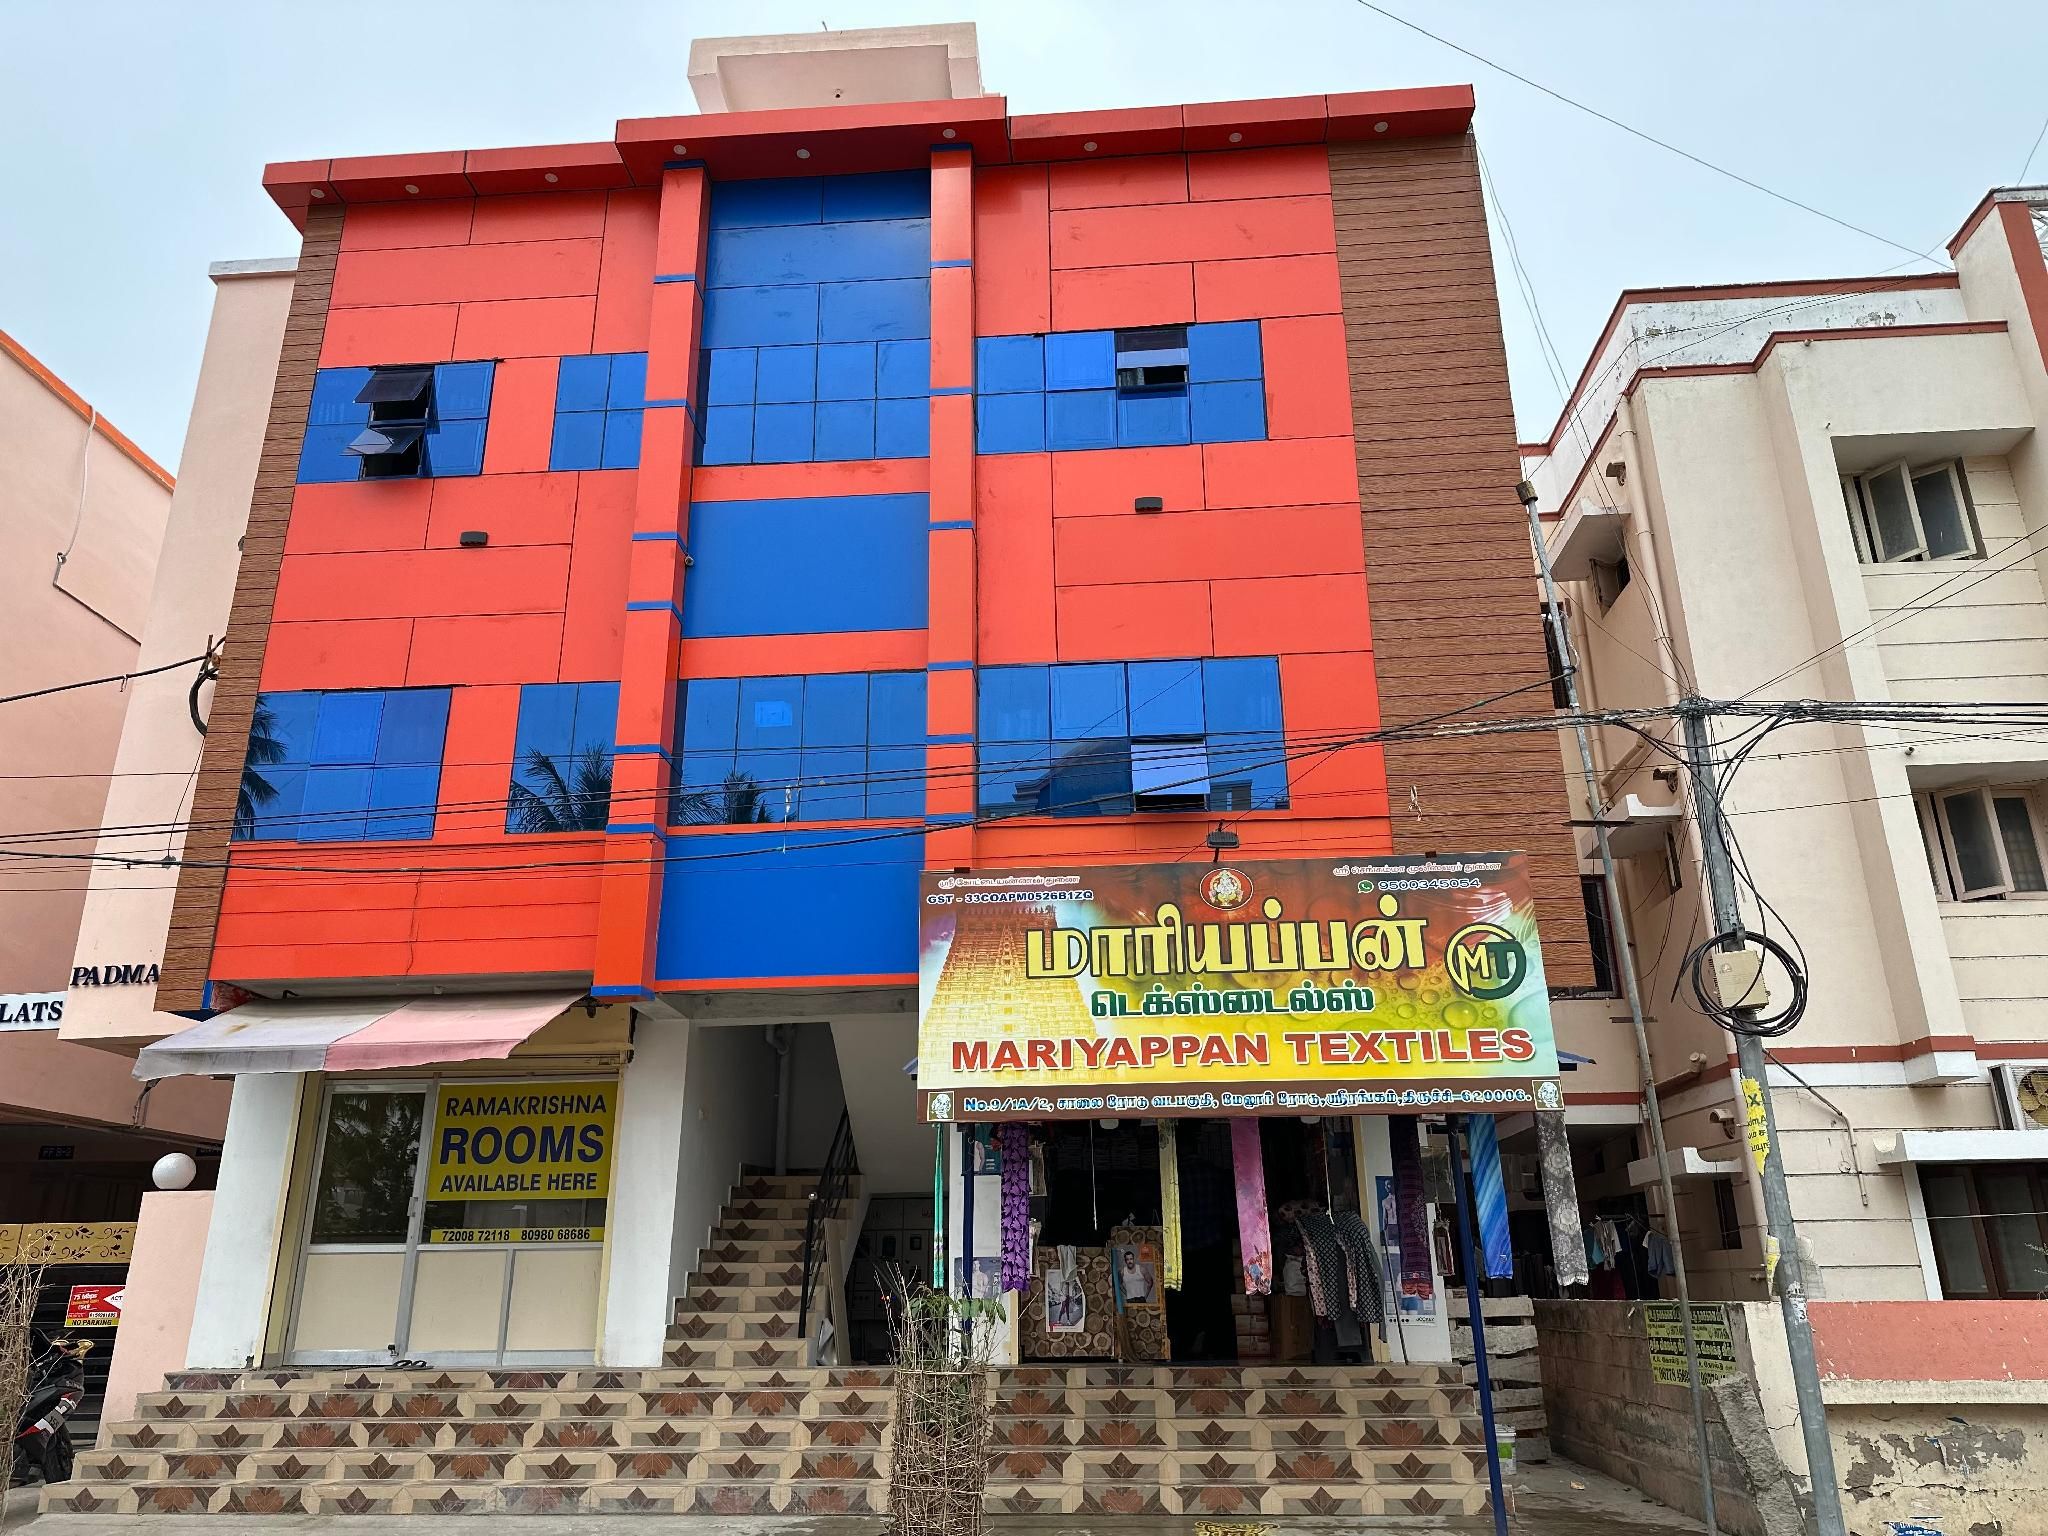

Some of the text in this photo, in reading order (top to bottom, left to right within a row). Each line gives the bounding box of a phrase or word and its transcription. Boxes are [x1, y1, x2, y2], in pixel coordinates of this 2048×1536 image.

[1378, 878, 1481, 890] 9500345054
[927, 894, 953, 904] GST
[1025, 894, 1427, 980] மாரியப்பன்
[70, 963, 160, 986] PADMA
[1090, 980, 1376, 1019] டெக்ஸ்டைல்ஸ்
[951, 1028, 1535, 1073] MARIYAPPAN TEXTILES
[445, 1094, 607, 1117] RAMAKRISHNA
[964, 1097, 1054, 1112] No.9/1A/2,
[1057, 1097, 1103, 1110] சாலை
[1107, 1094, 1149, 1110] ரோடு
[1222, 1091, 1274, 1109] மேலூர்
[439, 1124, 604, 1165] ROOMS
[440, 1172, 597, 1193] AVAILABLE HERE
[442, 1228, 590, 1242] 72008 72118 80980 68686
